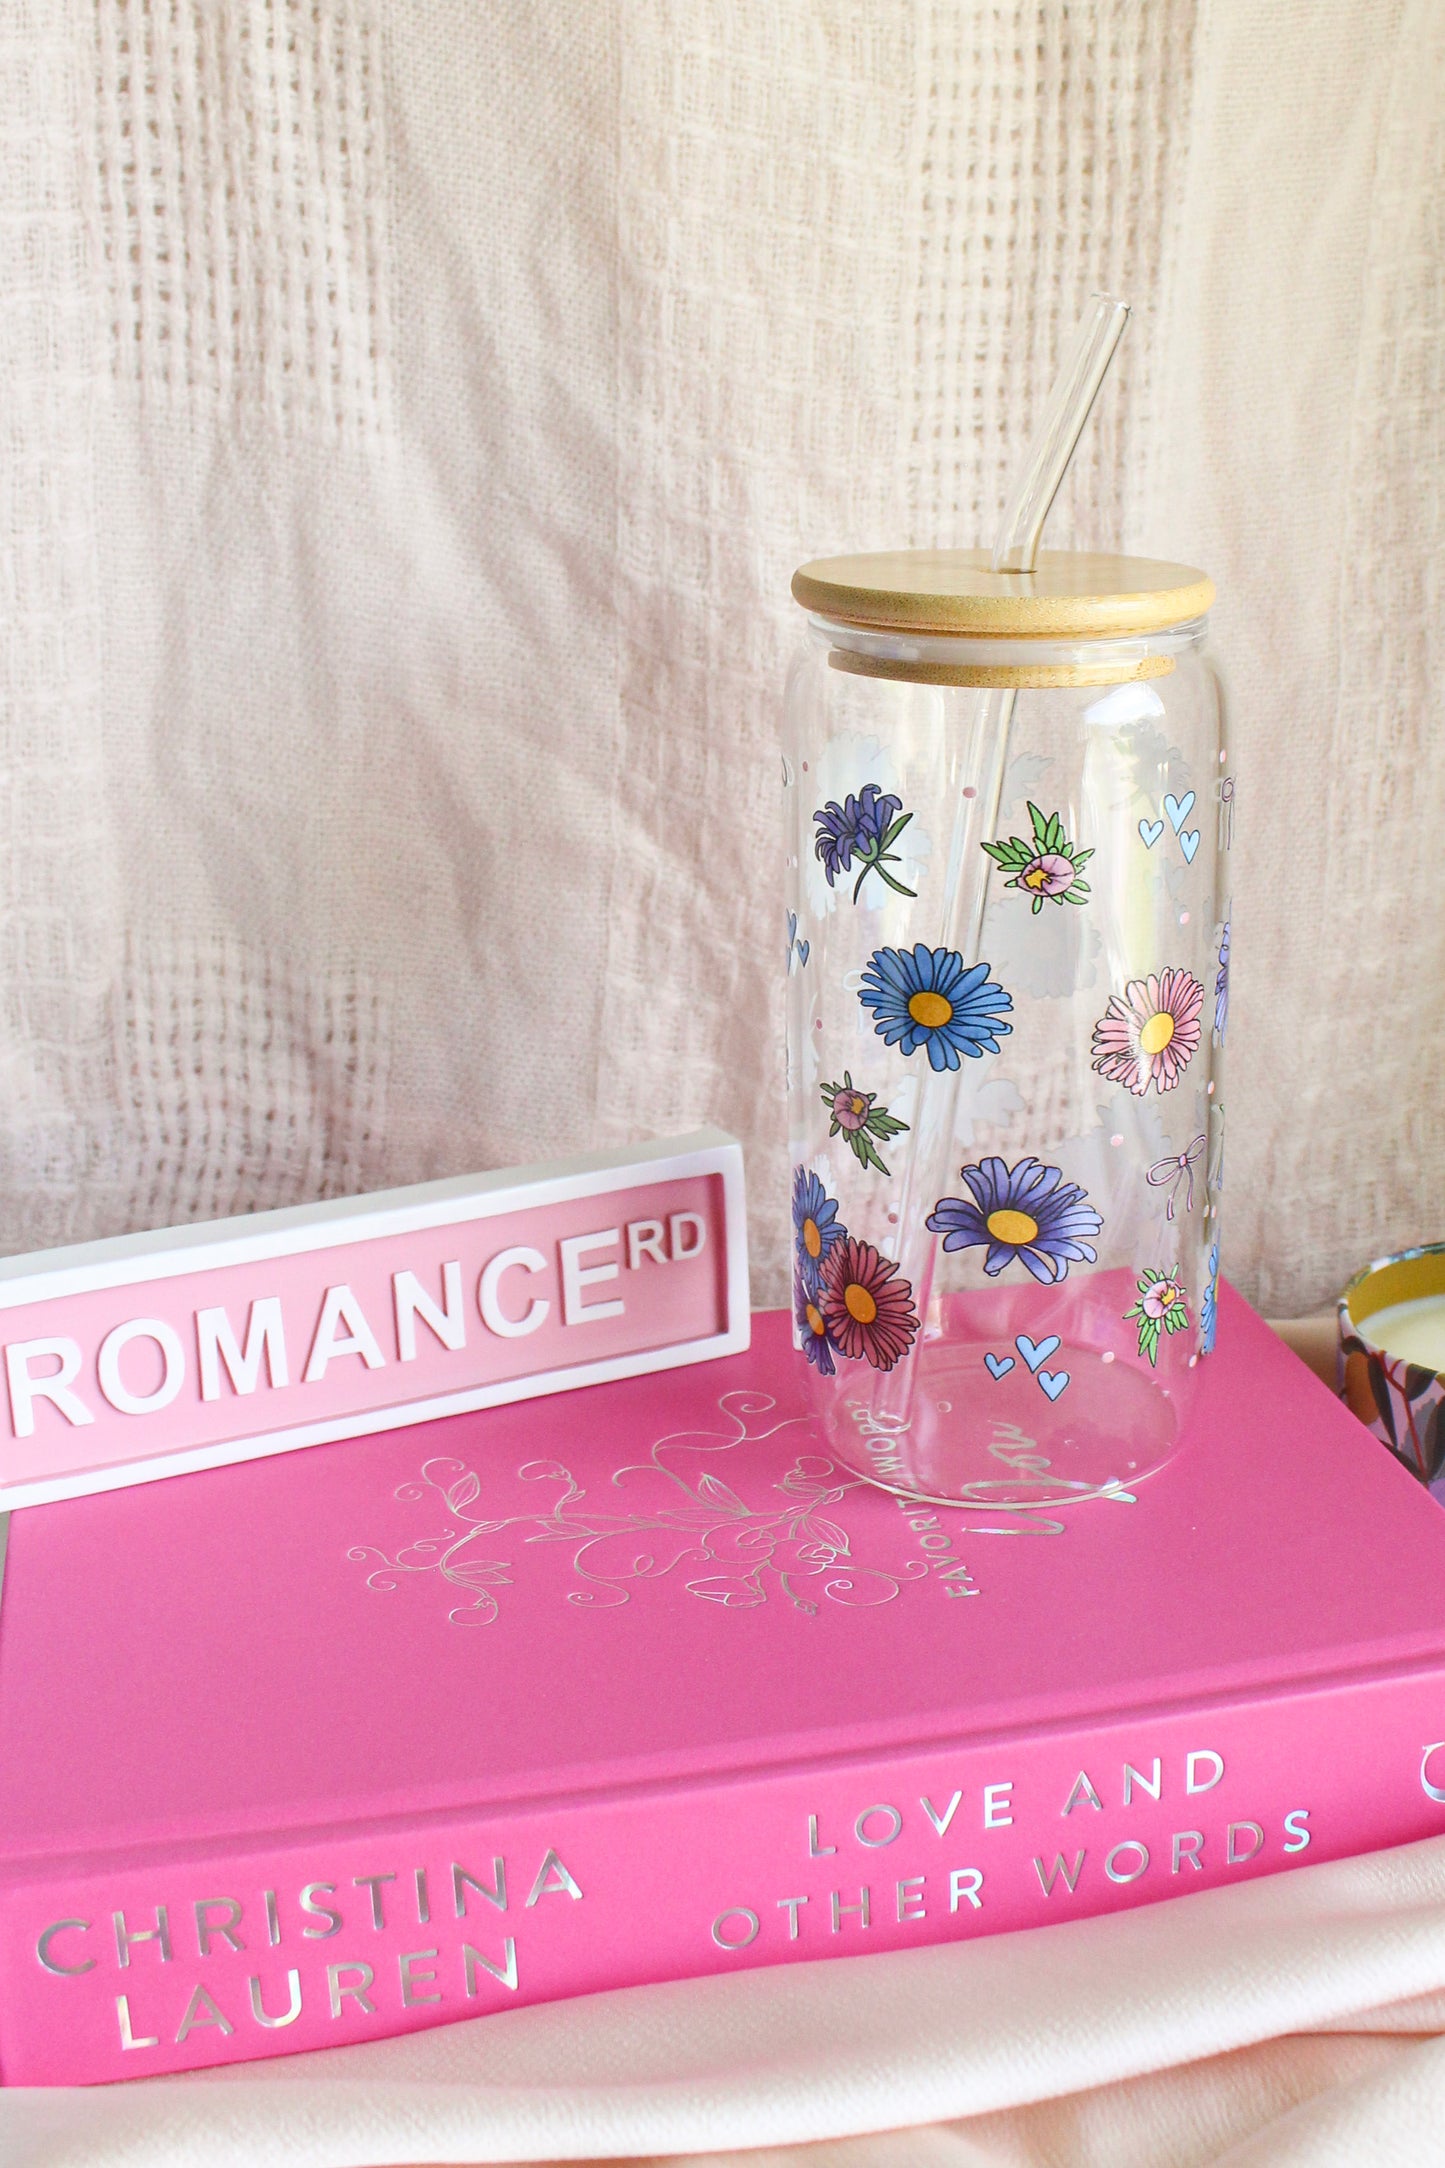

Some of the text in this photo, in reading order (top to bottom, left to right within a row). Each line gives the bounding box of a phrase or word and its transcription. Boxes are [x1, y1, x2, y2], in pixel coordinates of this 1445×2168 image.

[4, 1212, 707, 1438] ROMANCE RD
[896, 1480, 982, 1599] FAVORIT
[808, 1749, 1225, 1858] LOVE AND
[36, 1848, 584, 1977] CHRISTINA
[711, 1809, 1312, 1951] OTHER WORDS
[114, 1936, 519, 2051] LAUREN
